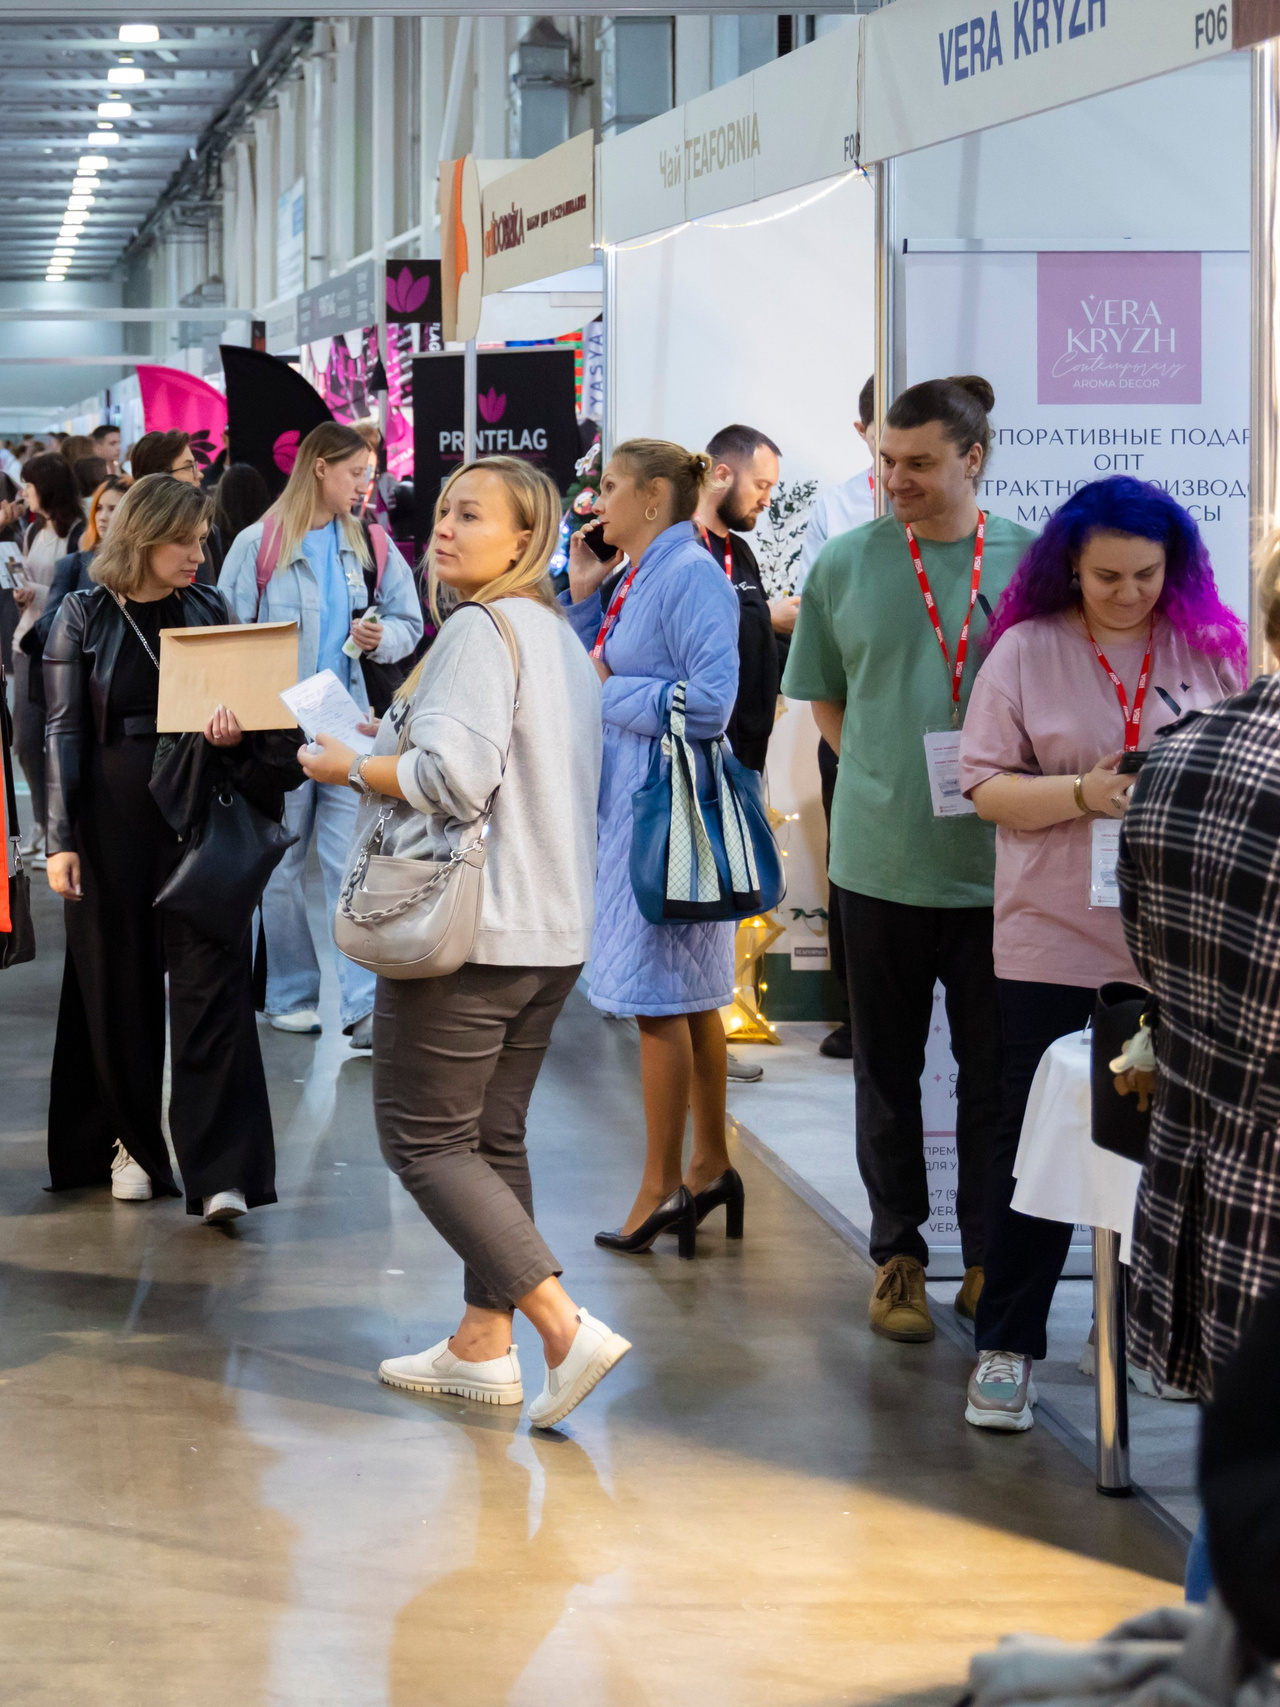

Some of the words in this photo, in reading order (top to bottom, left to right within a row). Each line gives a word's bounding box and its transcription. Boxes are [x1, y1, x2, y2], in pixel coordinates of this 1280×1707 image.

[1195, 3, 1227, 49] F06
[938, 10, 1003, 86] VERA
[660, 145, 681, 189] Чай
[684, 112, 761, 180] TEAFORNIA
[1080, 299, 1163, 326] VERA
[1067, 327, 1175, 353] KRYZH
[1052, 350, 1186, 378] Contemporary
[1073, 379, 1116, 389] AROMA
[1119, 379, 1160, 389] DECOR
[439, 428, 548, 452] PRNTFLAG
[1094, 454, 1144, 471] ОПТ
